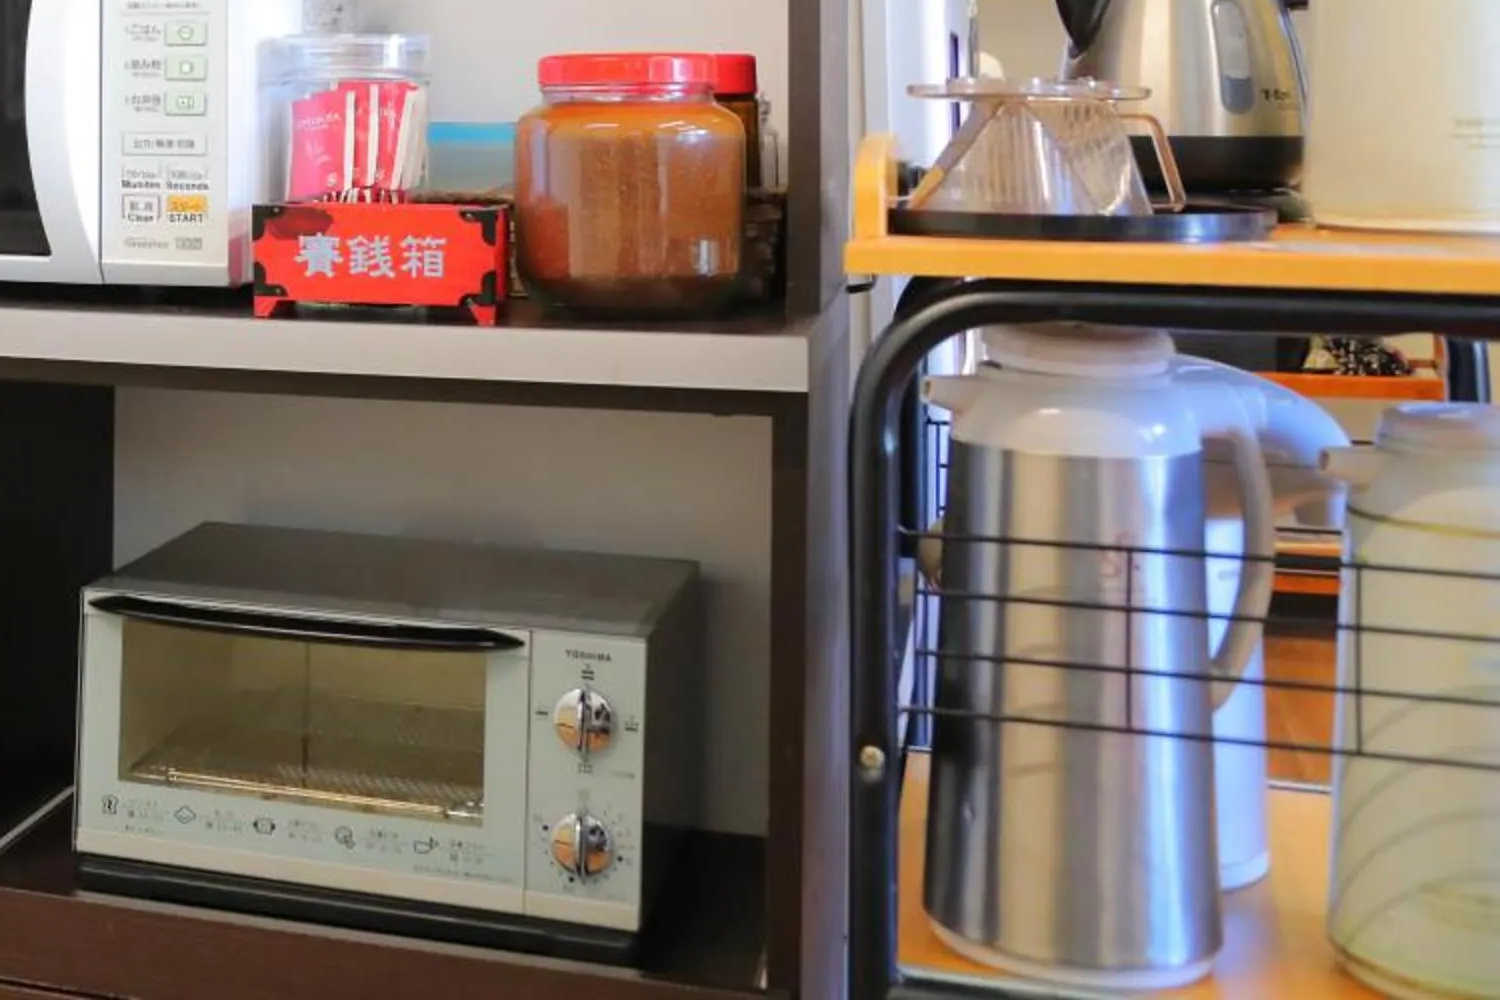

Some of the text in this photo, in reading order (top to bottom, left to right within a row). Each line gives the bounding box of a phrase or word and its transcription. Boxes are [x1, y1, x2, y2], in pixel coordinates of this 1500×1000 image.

[168, 213, 204, 223] START
[294, 231, 447, 279] 賽銭箱
[565, 649, 612, 662] TOSHIBA
